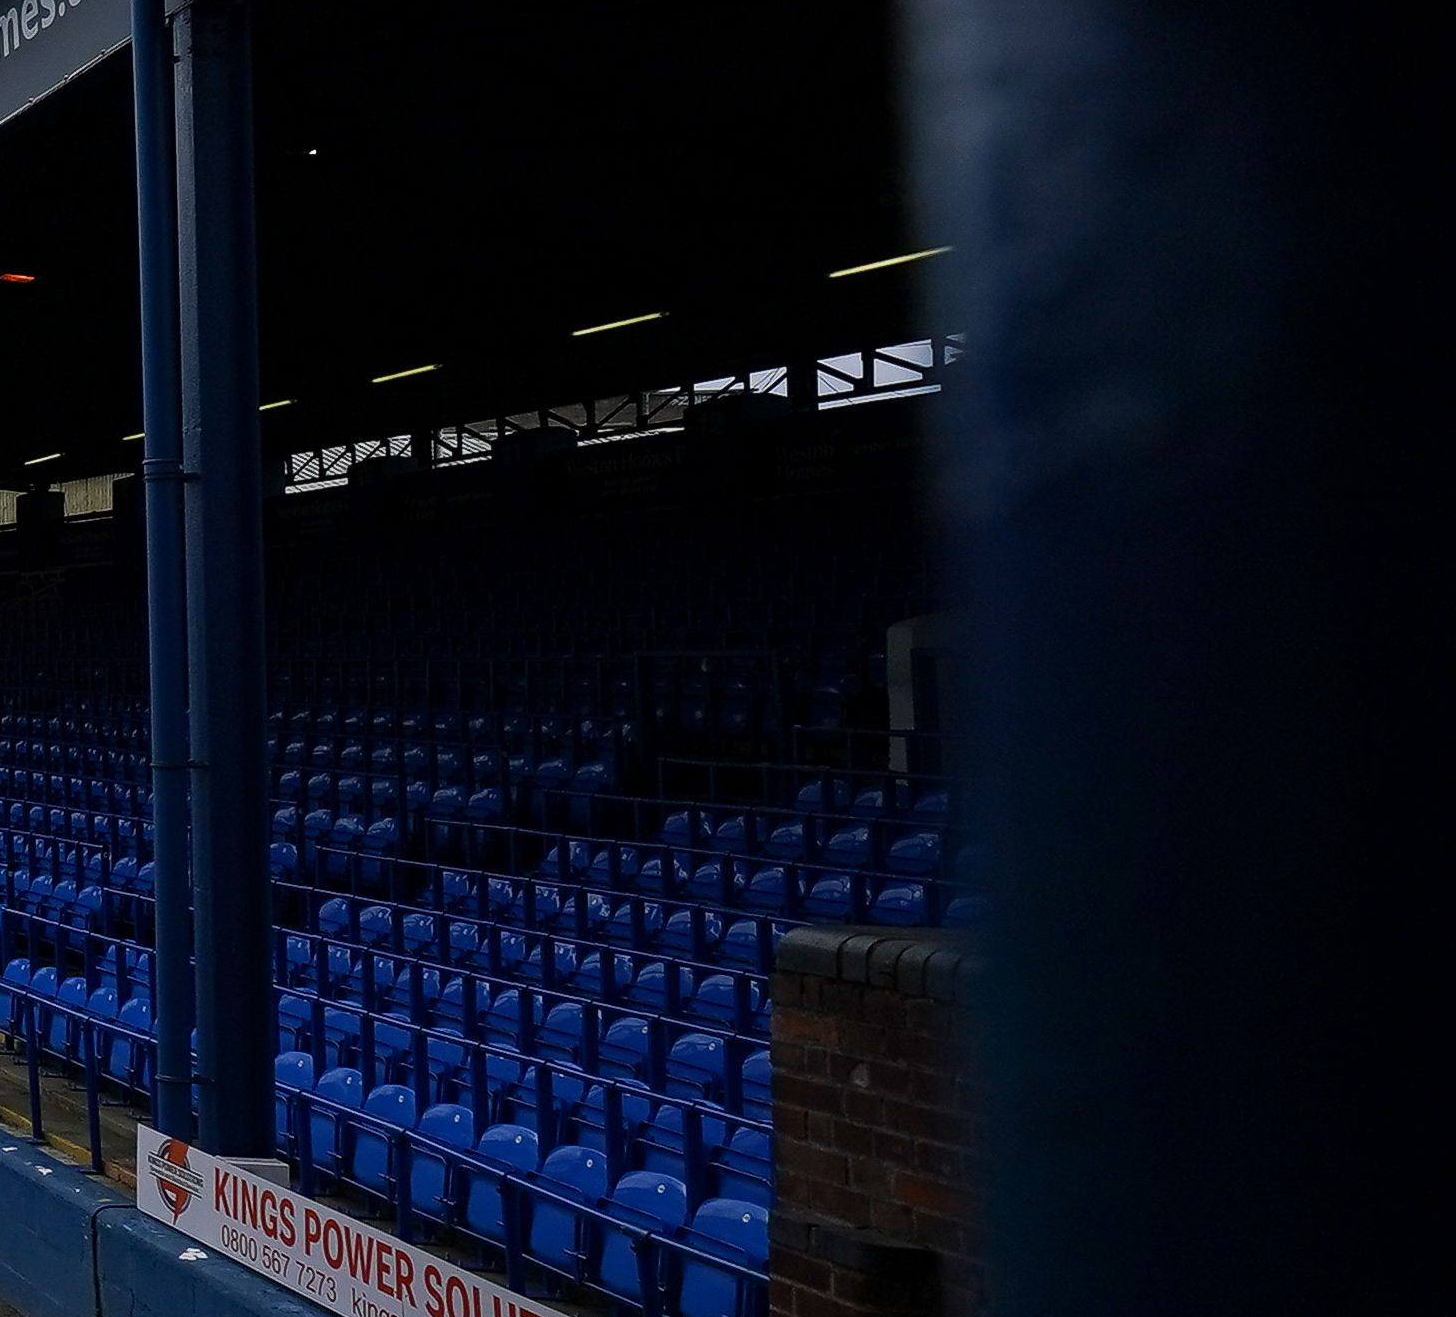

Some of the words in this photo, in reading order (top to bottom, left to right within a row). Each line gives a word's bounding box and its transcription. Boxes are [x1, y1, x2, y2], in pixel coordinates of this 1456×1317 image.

[214, 1166, 297, 1249] KINGS
[303, 1206, 418, 1309] POWER
[221, 1223, 258, 1263] 0800
[261, 1244, 291, 1279] 567
[295, 1259, 337, 1304] 7273
